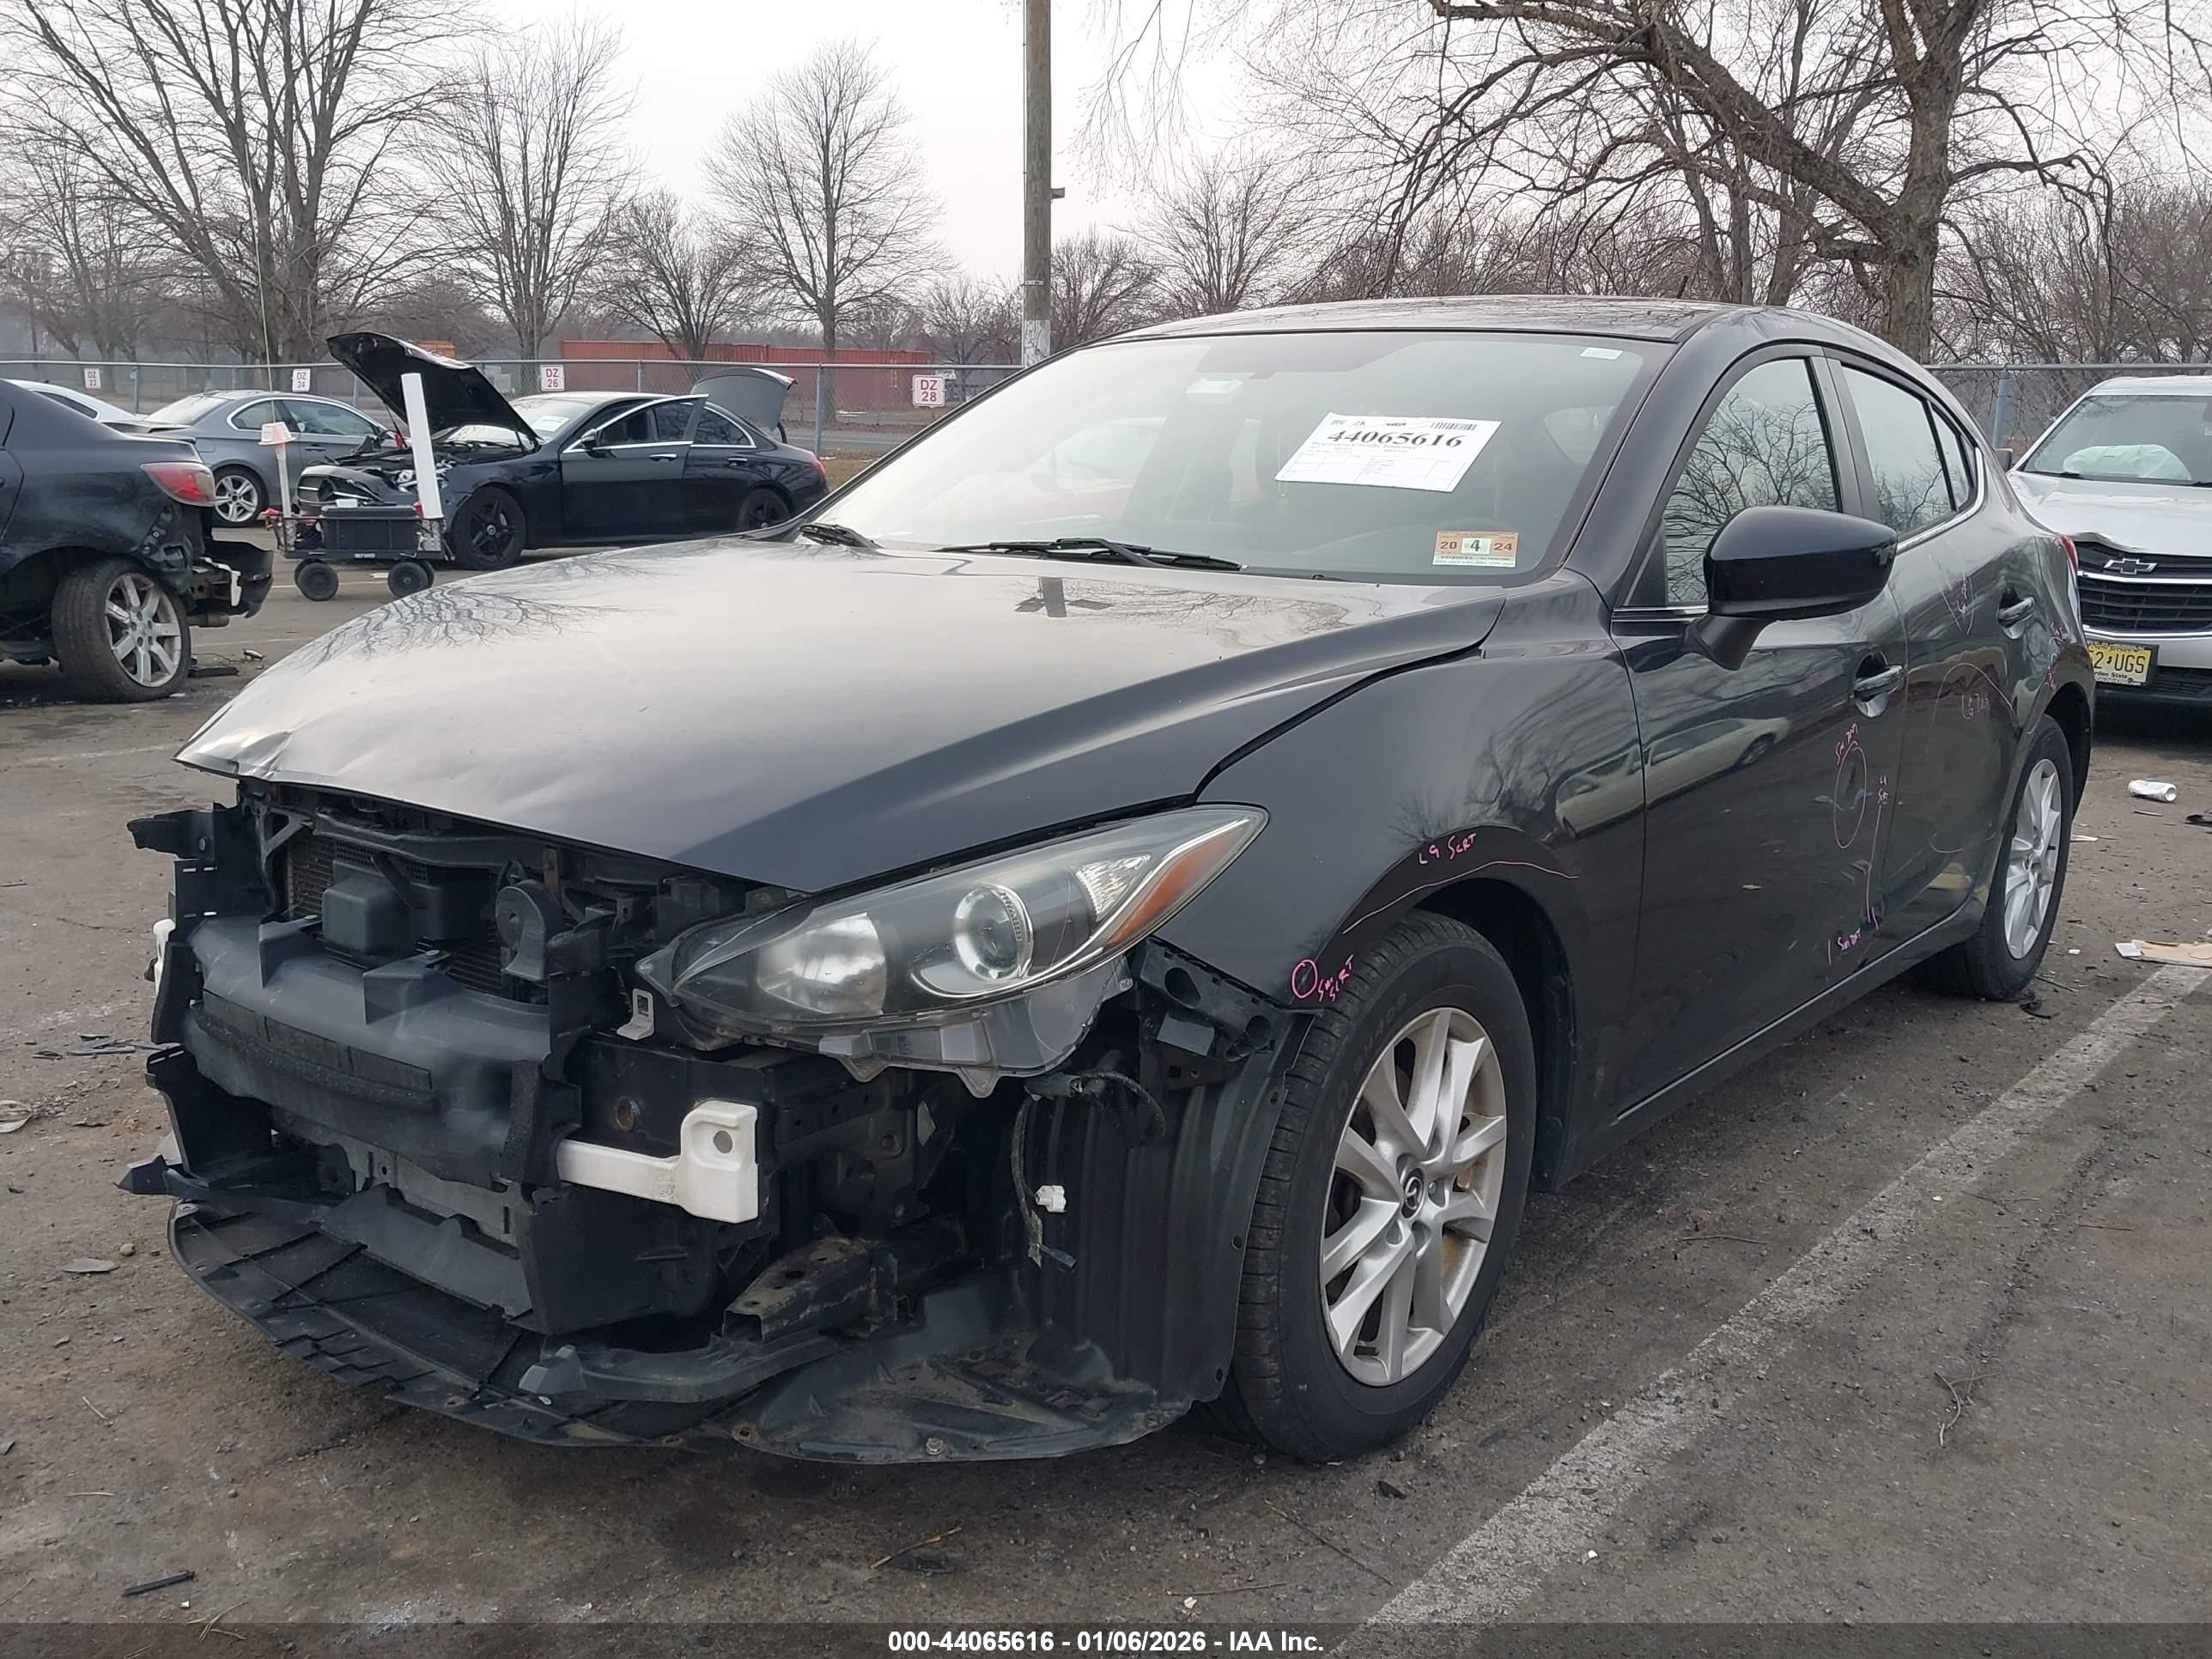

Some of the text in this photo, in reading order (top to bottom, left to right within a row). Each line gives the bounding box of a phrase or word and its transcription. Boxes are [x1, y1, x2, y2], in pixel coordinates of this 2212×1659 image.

[296, 372, 307, 380] DZ
[545, 368, 559, 378] DZ
[547, 379, 558, 388] 26
[921, 380, 938, 391] DZ
[921, 391, 937, 402] 28
[1328, 430, 1468, 448] 44065616
[1440, 538, 1513, 552] 20 4 24
[2114, 653, 2146, 674] UGS
